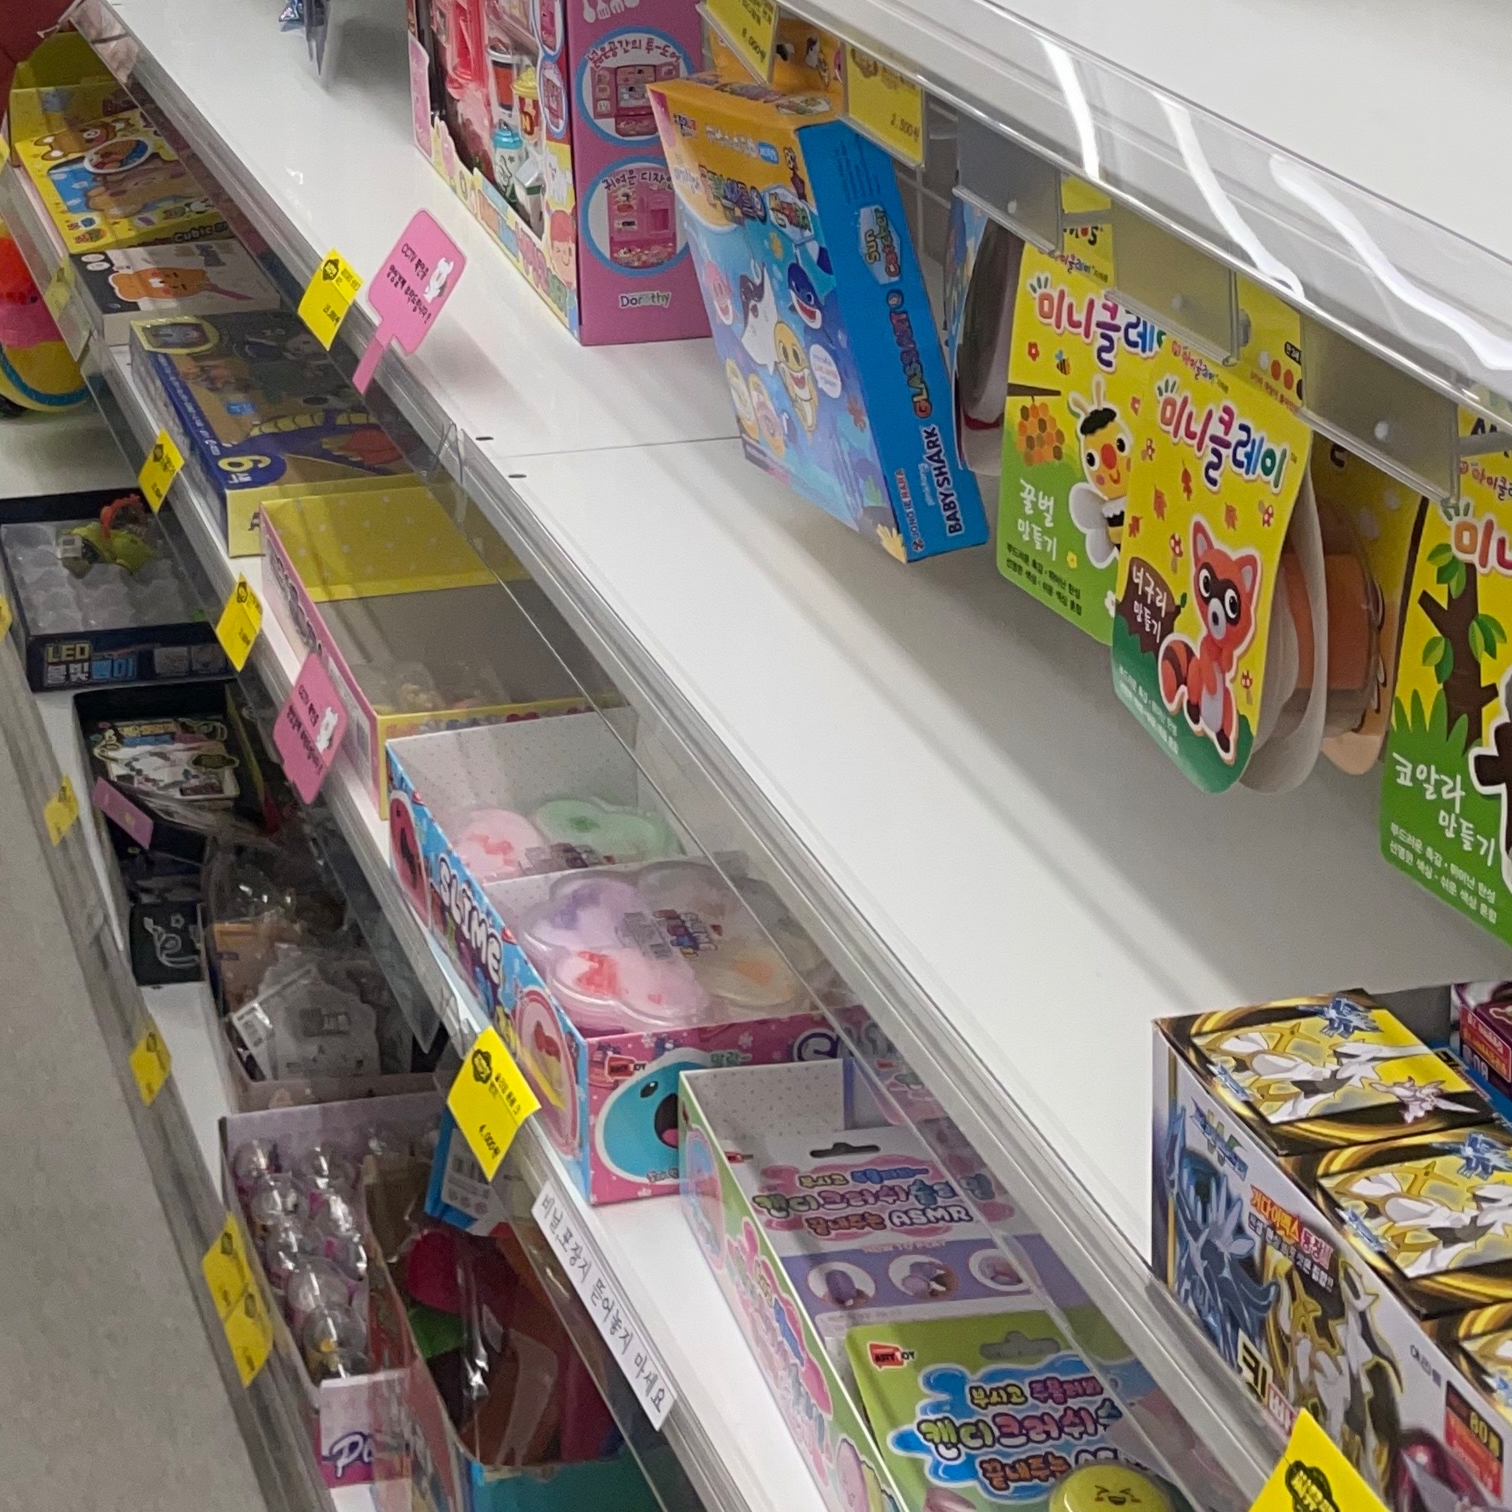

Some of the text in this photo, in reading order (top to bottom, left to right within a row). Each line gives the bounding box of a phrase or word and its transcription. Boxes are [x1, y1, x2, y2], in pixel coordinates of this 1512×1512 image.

[602, 171, 637, 191] 귀여운
[401, 244, 416, 262] CCTV
[864, 229, 881, 265] Sun
[1037, 289, 1167, 369] 미니클레
[1159, 395, 1288, 489] 미니클레이
[922, 423, 964, 536] BABY SHARK
[1020, 478, 1055, 527] 꿀벌
[1018, 519, 1057, 561] 만들기
[1132, 565, 1168, 618] 너구리
[1133, 600, 1162, 643] 만들기
[45, 642, 90, 663] LED
[1392, 751, 1466, 815] 코알라
[1438, 809, 1495, 867] 만들기
[439, 856, 503, 988] SLIME
[805, 1204, 973, 1237] 끝내주는 ASMR
[1250, 1185, 1304, 1245] 거다이맥스
[635, 1353, 665, 1414] 마세요
[969, 1383, 1028, 1410] 부시고
